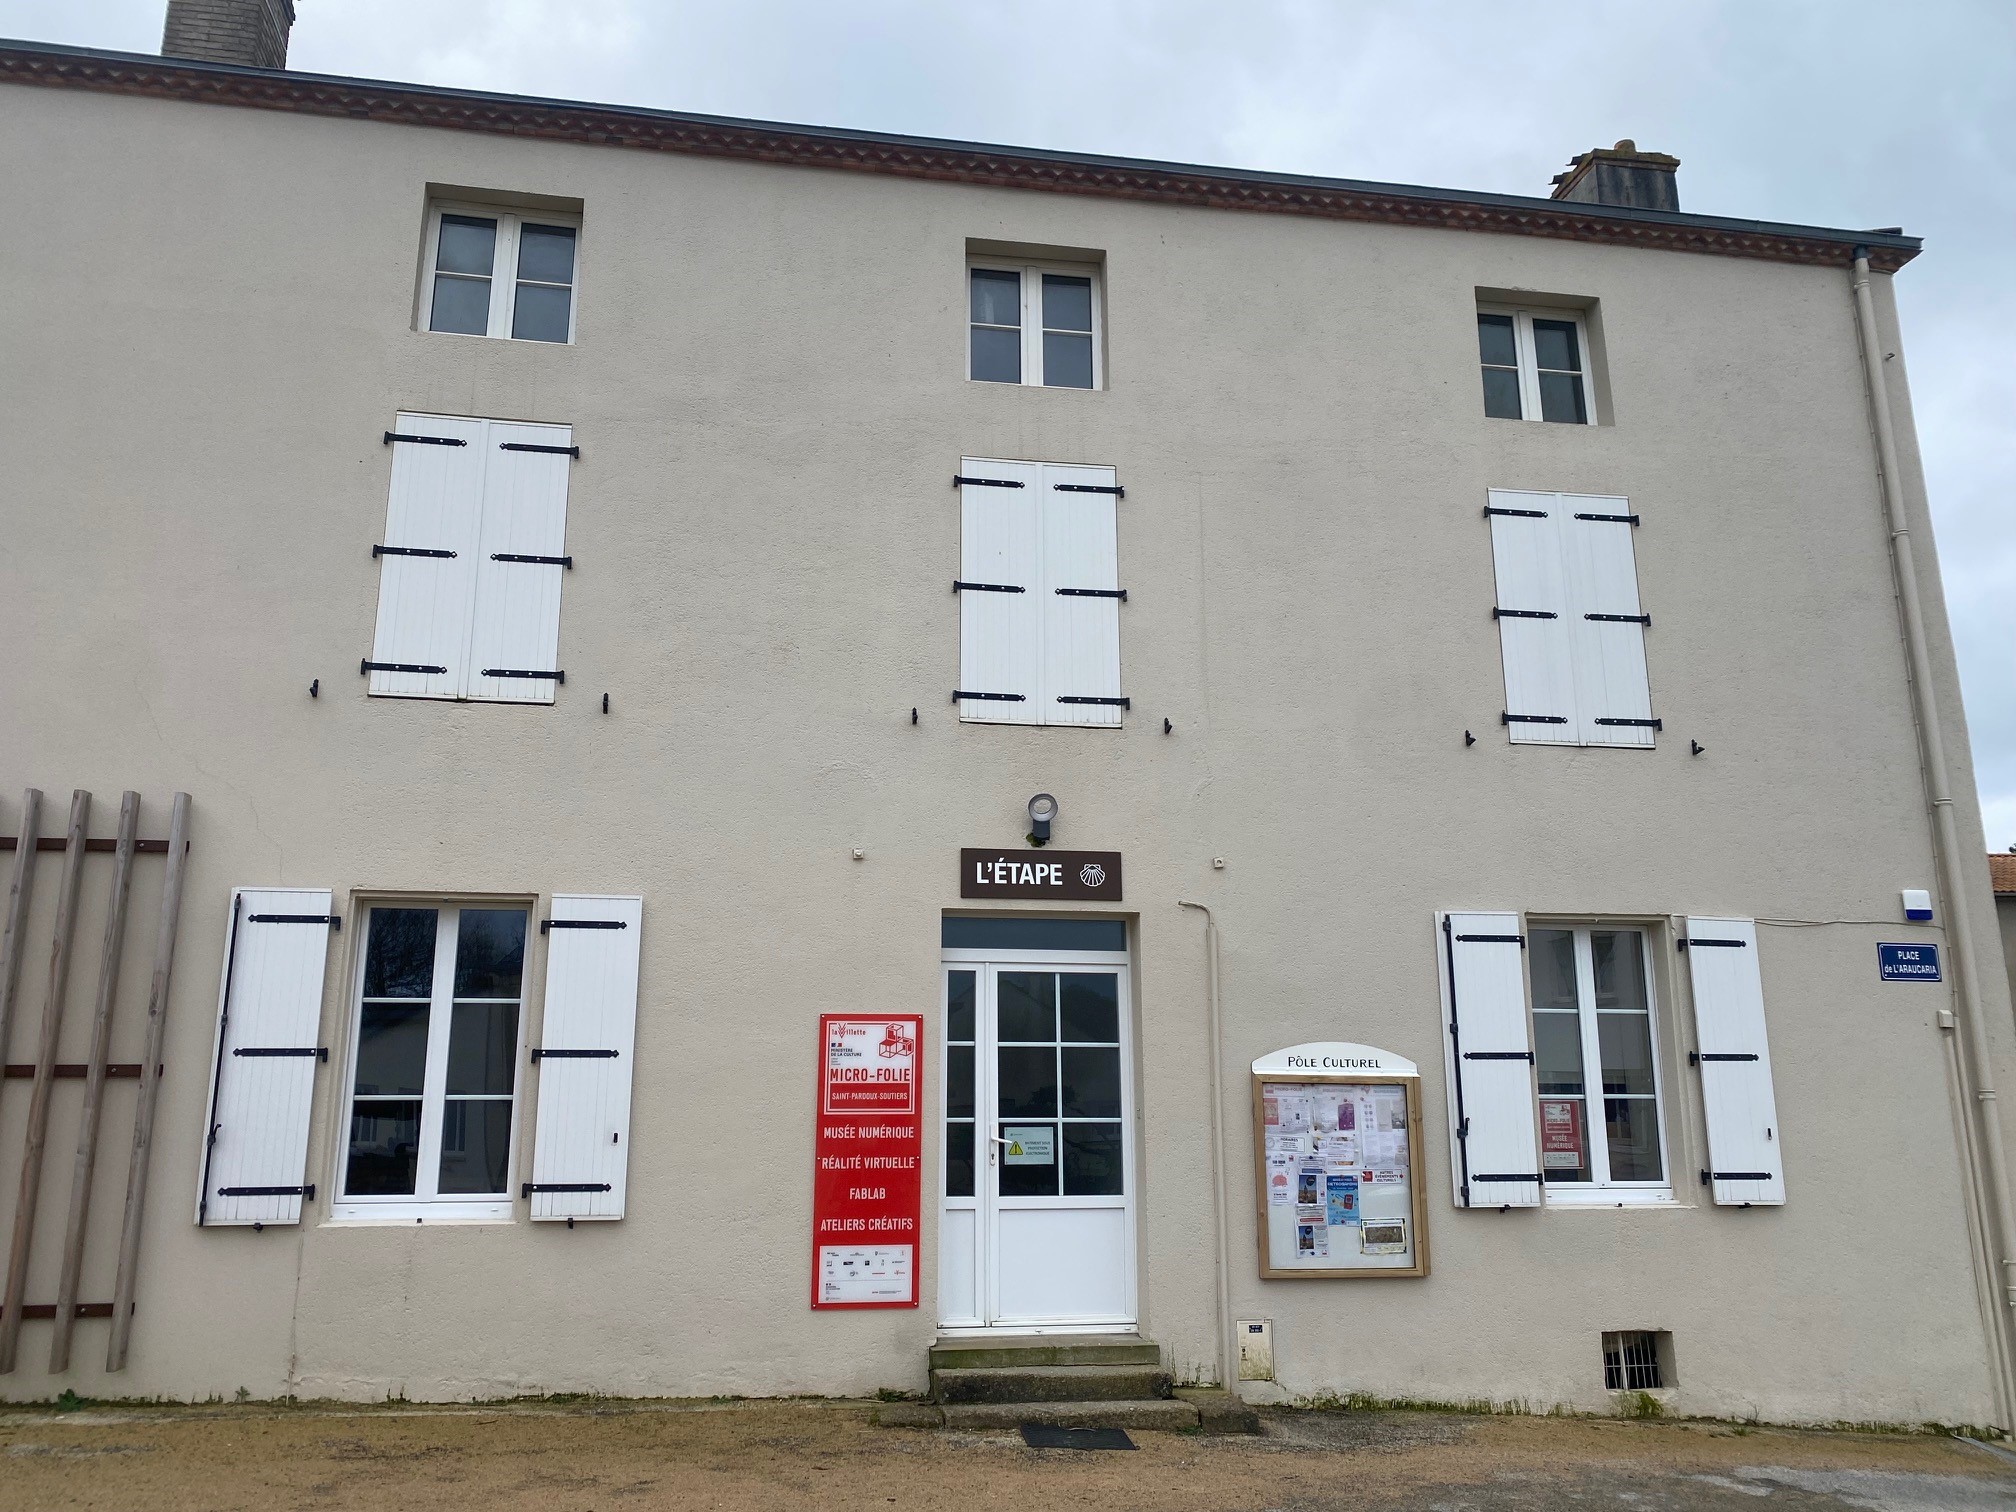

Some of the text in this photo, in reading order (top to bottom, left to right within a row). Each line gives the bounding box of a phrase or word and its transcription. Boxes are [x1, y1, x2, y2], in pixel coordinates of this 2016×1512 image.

[976, 857, 1063, 885] L'ÉTAPE
[1897, 951, 1920, 960] PLACE
[1884, 964, 1937, 974] de L'ARAUCARIA
[1288, 1056, 1381, 1068] PÔLE CULTUREL
[830, 1068, 910, 1082] MICRO-FOLIE
[824, 1124, 914, 1139] MUSÉE NUMÉRIQUE
[1546, 1141, 1574, 1149] NUMÉRIQUE
[822, 1154, 915, 1169] RÉALITÉ VIRTUELLE
[849, 1187, 886, 1200] FABLAB
[820, 1215, 913, 1231] ATELIERS CRÉATIFS
